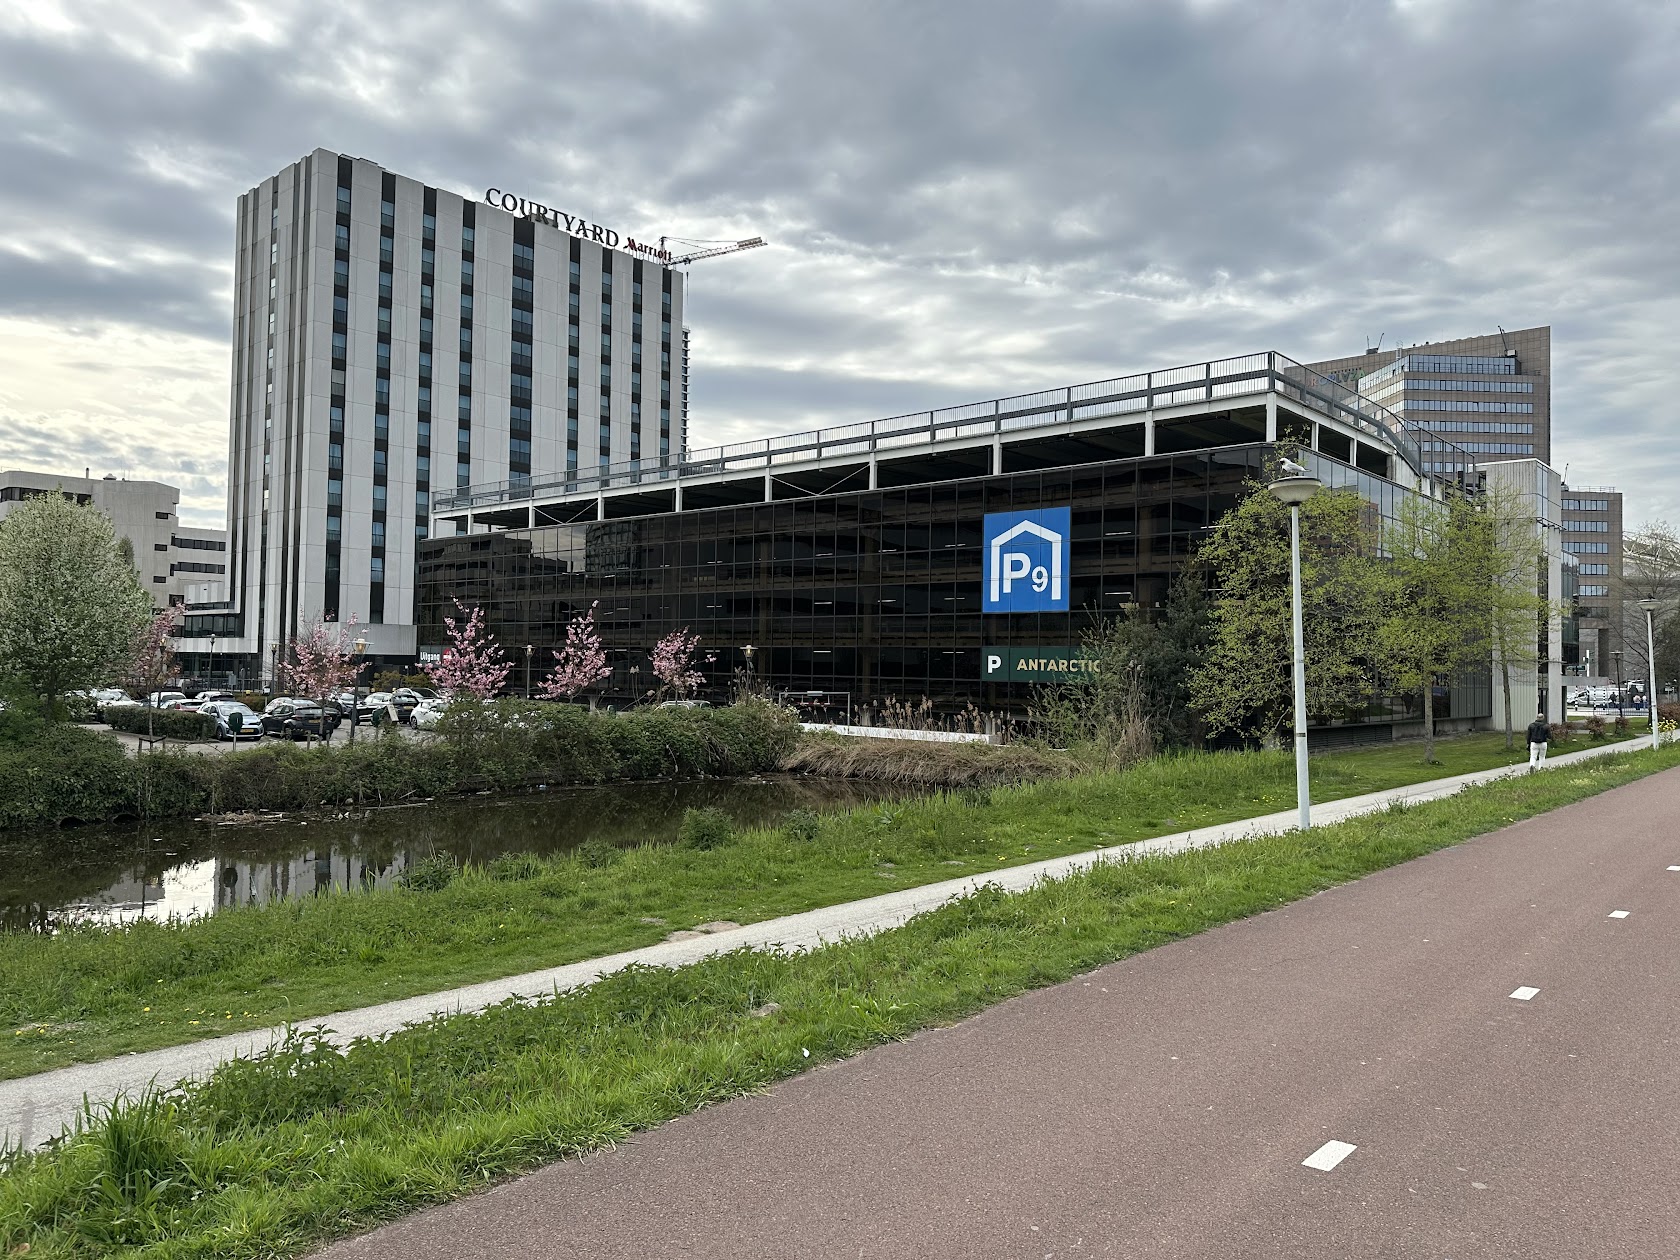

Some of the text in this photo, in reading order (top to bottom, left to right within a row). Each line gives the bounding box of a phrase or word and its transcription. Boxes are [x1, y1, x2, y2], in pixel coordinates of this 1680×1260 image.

[485, 187, 672, 262] COURTYARD Marriott
[420, 651, 440, 662] Uitgang
[987, 655, 1002, 674] P
